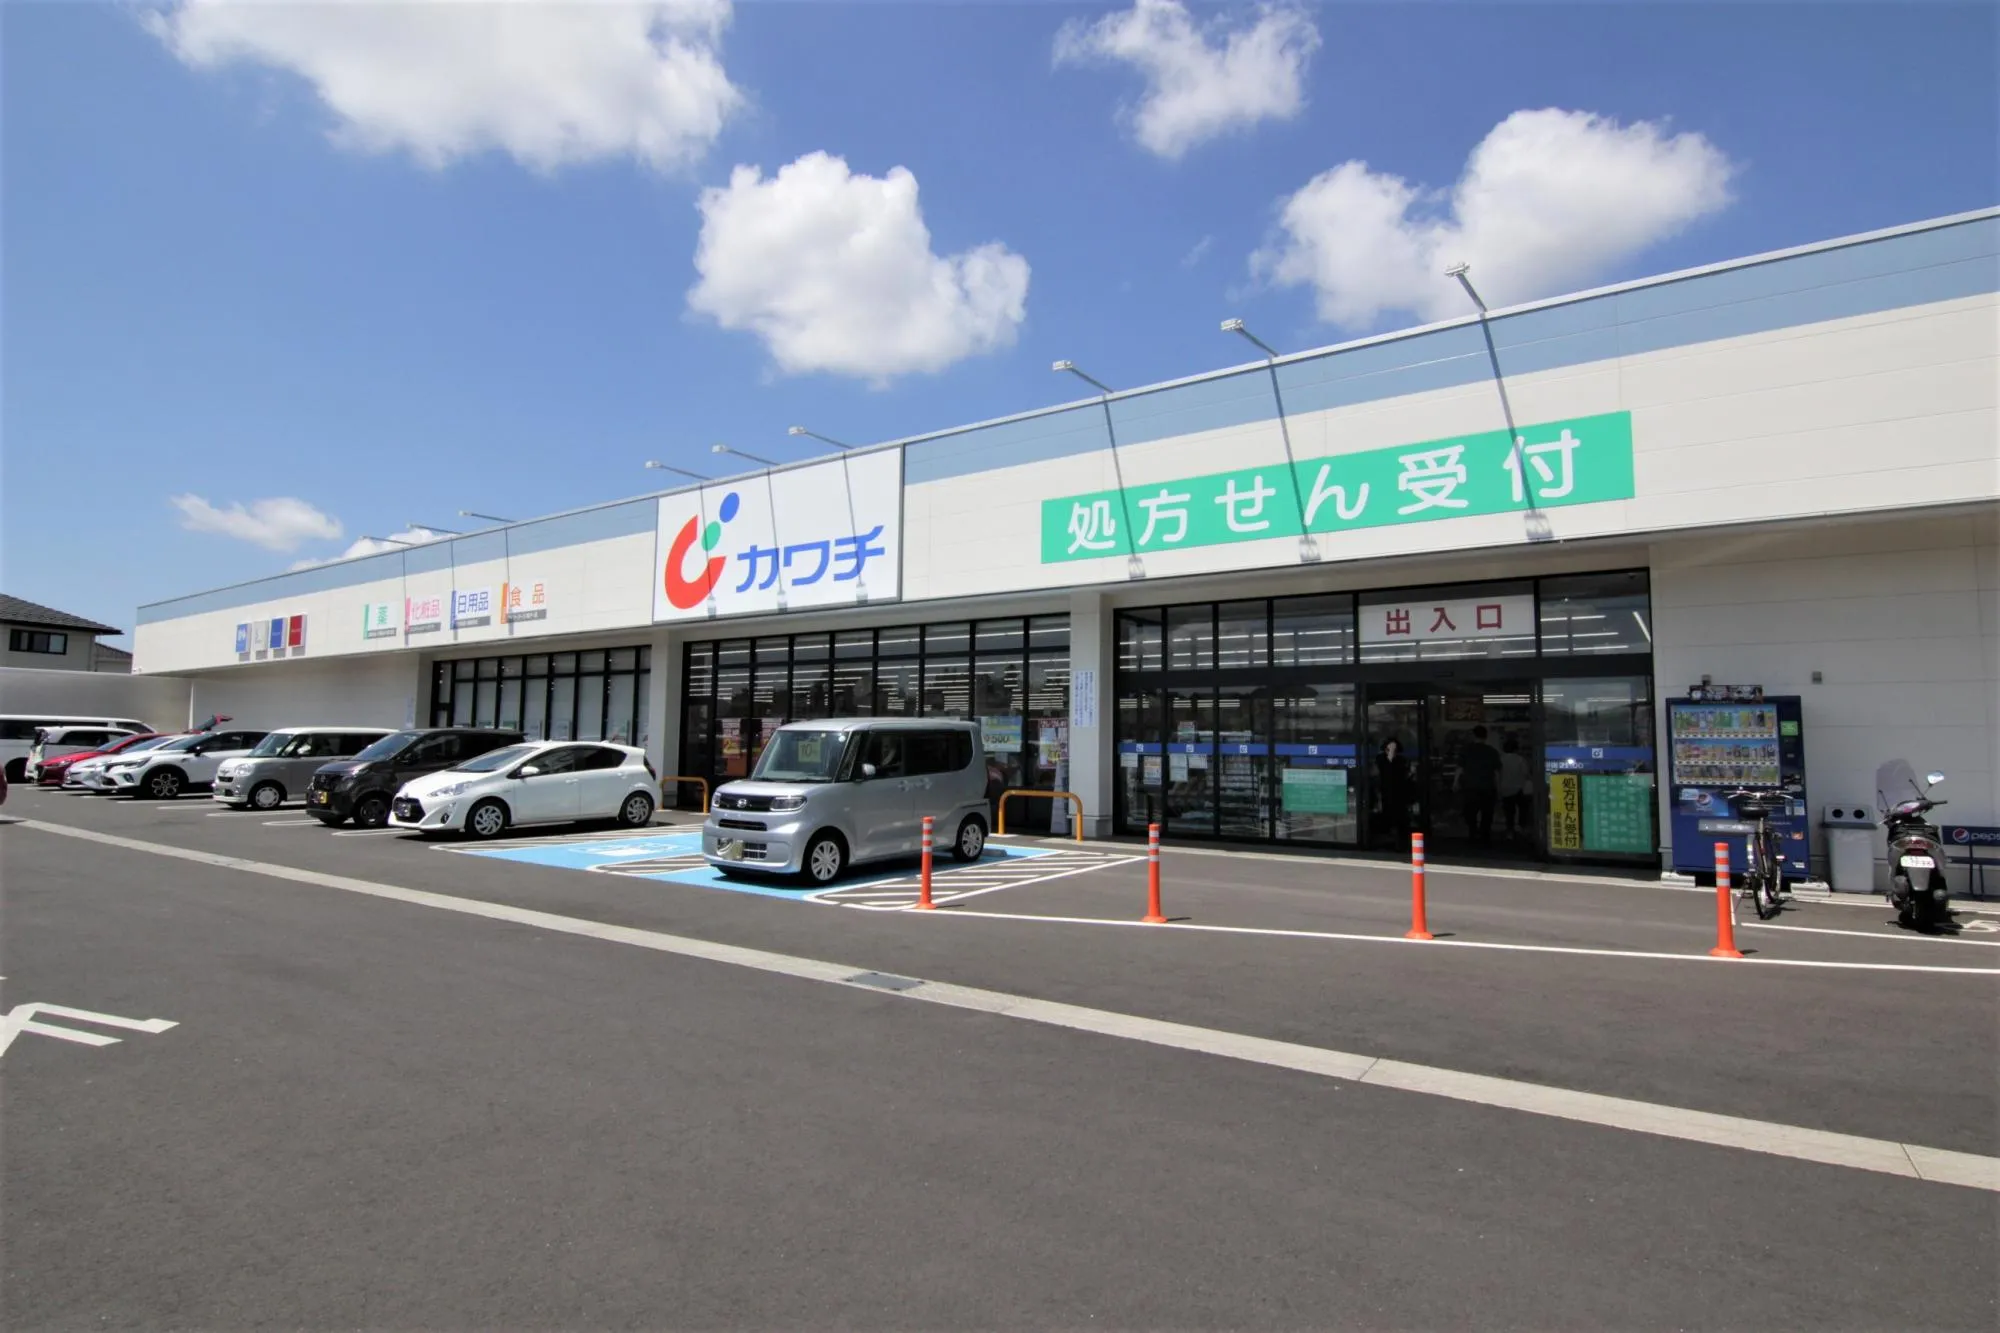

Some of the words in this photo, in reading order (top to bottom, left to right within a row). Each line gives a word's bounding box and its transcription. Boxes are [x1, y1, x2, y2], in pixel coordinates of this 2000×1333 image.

[1067, 429, 1581, 554] 処方せん受付
[736, 525, 885, 593] カワチ
[458, 591, 488, 613] 日用品
[511, 583, 544, 607] 食品
[1386, 604, 1503, 636] 出入口
[1562, 777, 1577, 847] 処方せん受付
